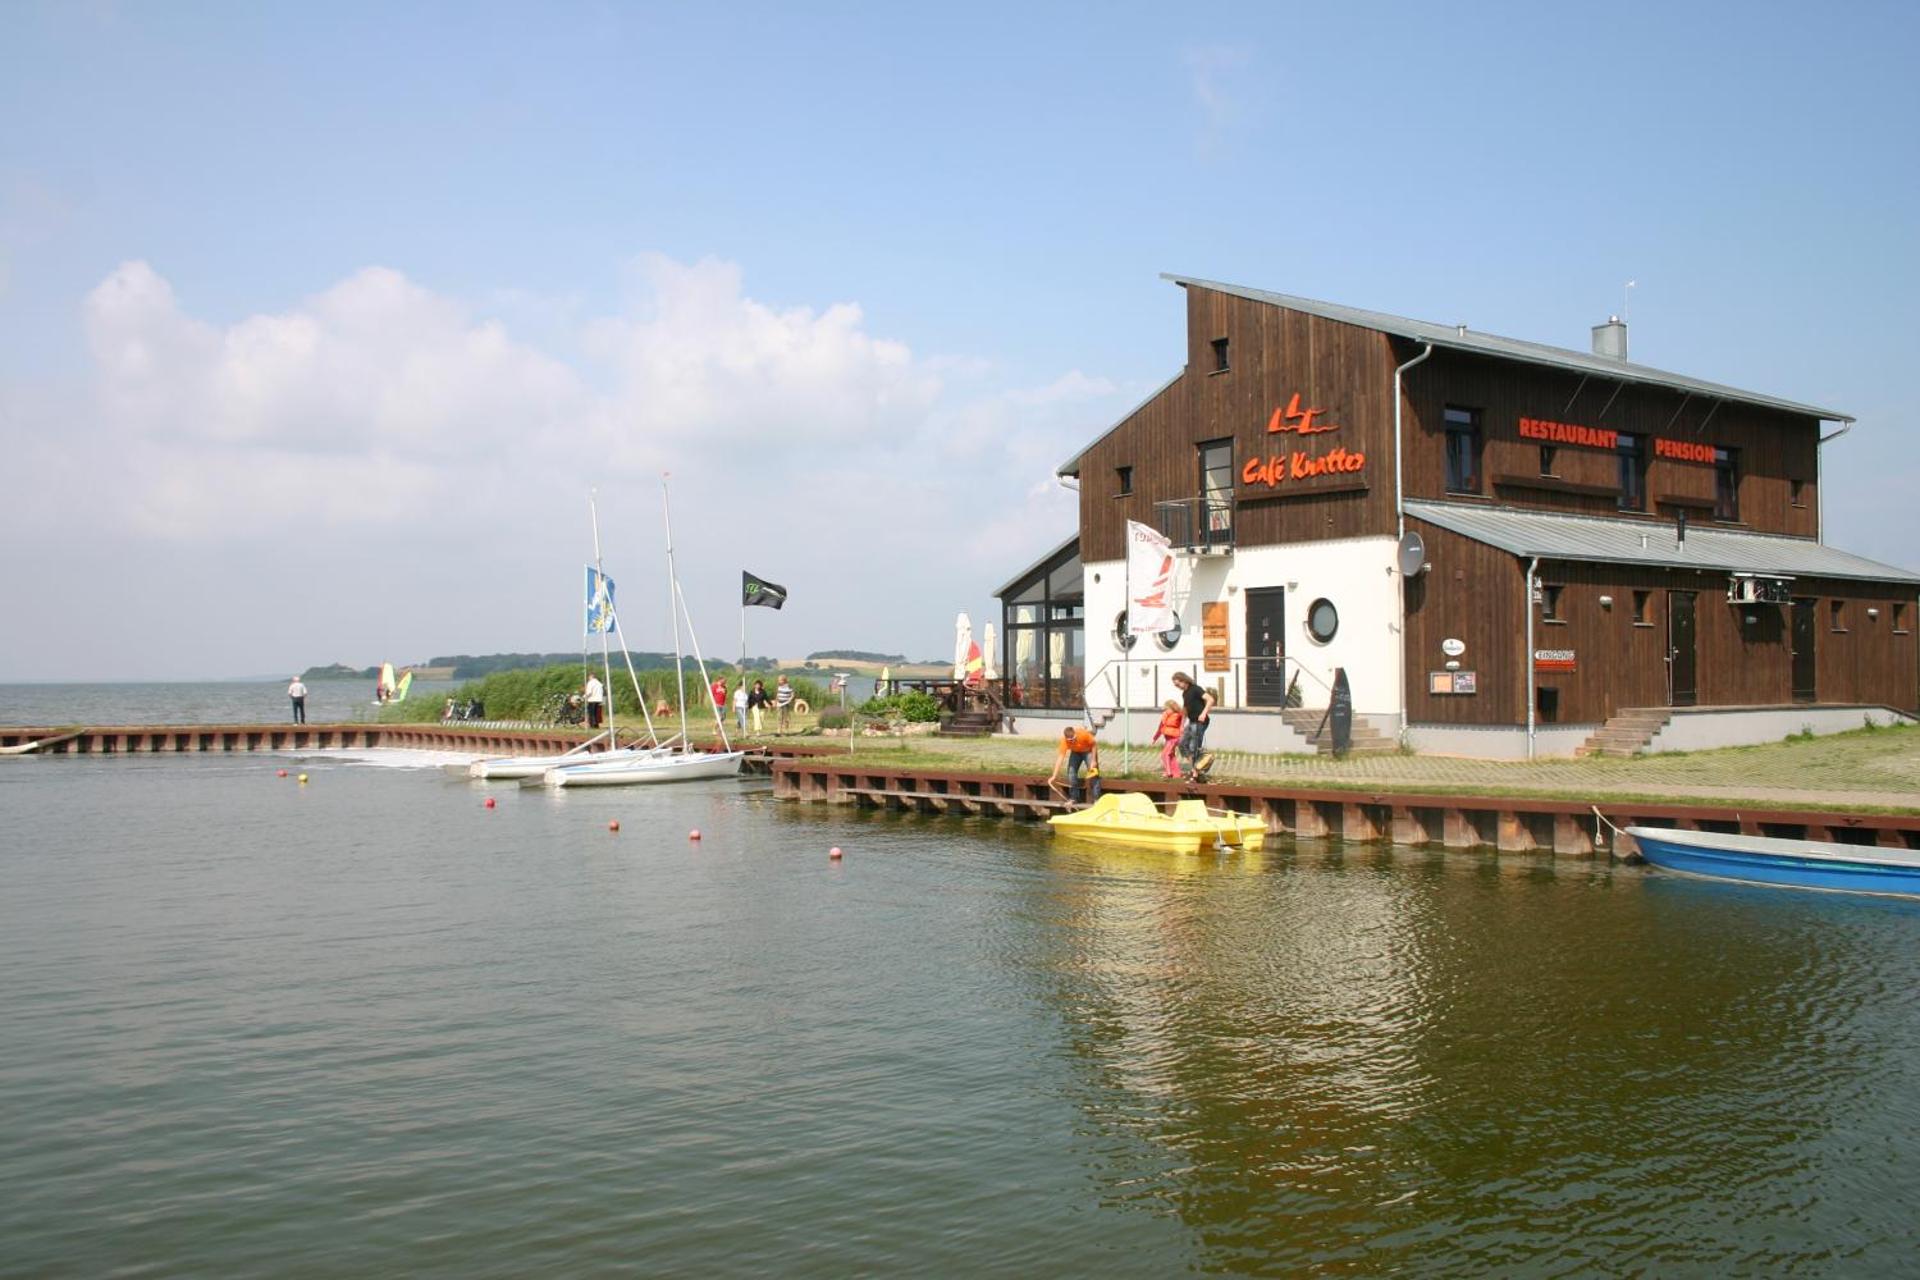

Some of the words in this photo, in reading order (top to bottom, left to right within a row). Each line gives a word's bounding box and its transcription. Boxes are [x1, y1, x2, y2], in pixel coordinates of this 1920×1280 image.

[1518, 416, 1618, 449] RESTAURANT
[1655, 438, 1716, 464] PENSION
[1242, 455, 1286, 487] Café
